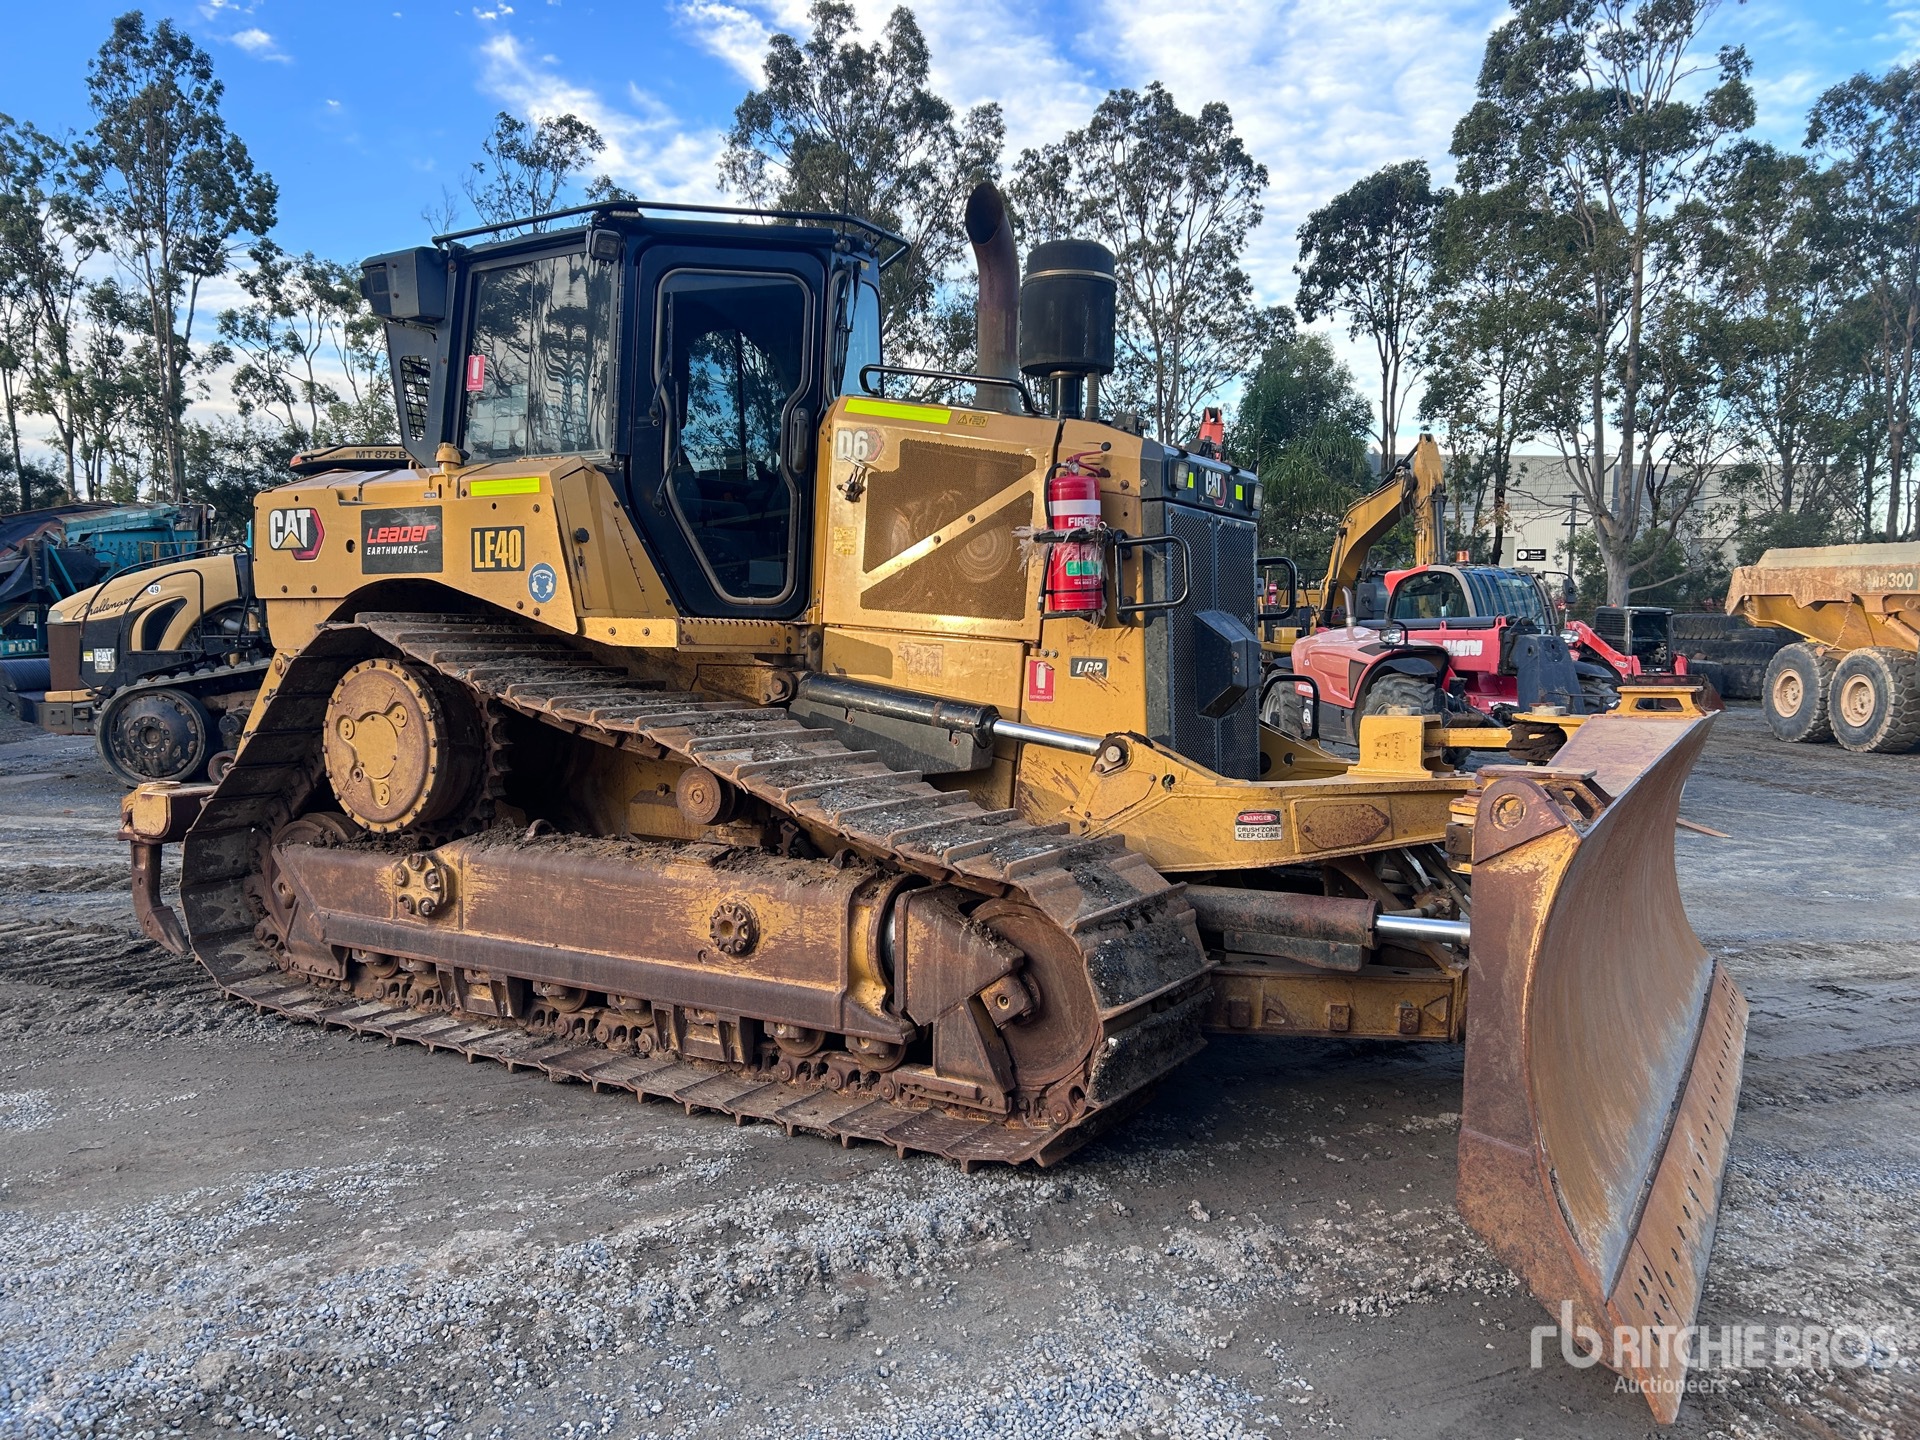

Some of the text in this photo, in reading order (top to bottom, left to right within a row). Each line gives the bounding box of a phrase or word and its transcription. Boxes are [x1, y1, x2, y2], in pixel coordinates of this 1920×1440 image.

[356, 451, 373, 459] MT
[375, 451, 396, 459] 875
[837, 430, 869, 460] D6
[1206, 470, 1221, 498] CAT
[270, 509, 311, 549] CAT
[367, 545, 418, 555] EARTHWORKS
[474, 529, 522, 568] LE40
[150, 586, 159, 594] 49
[1076, 661, 1103, 674] LGP
